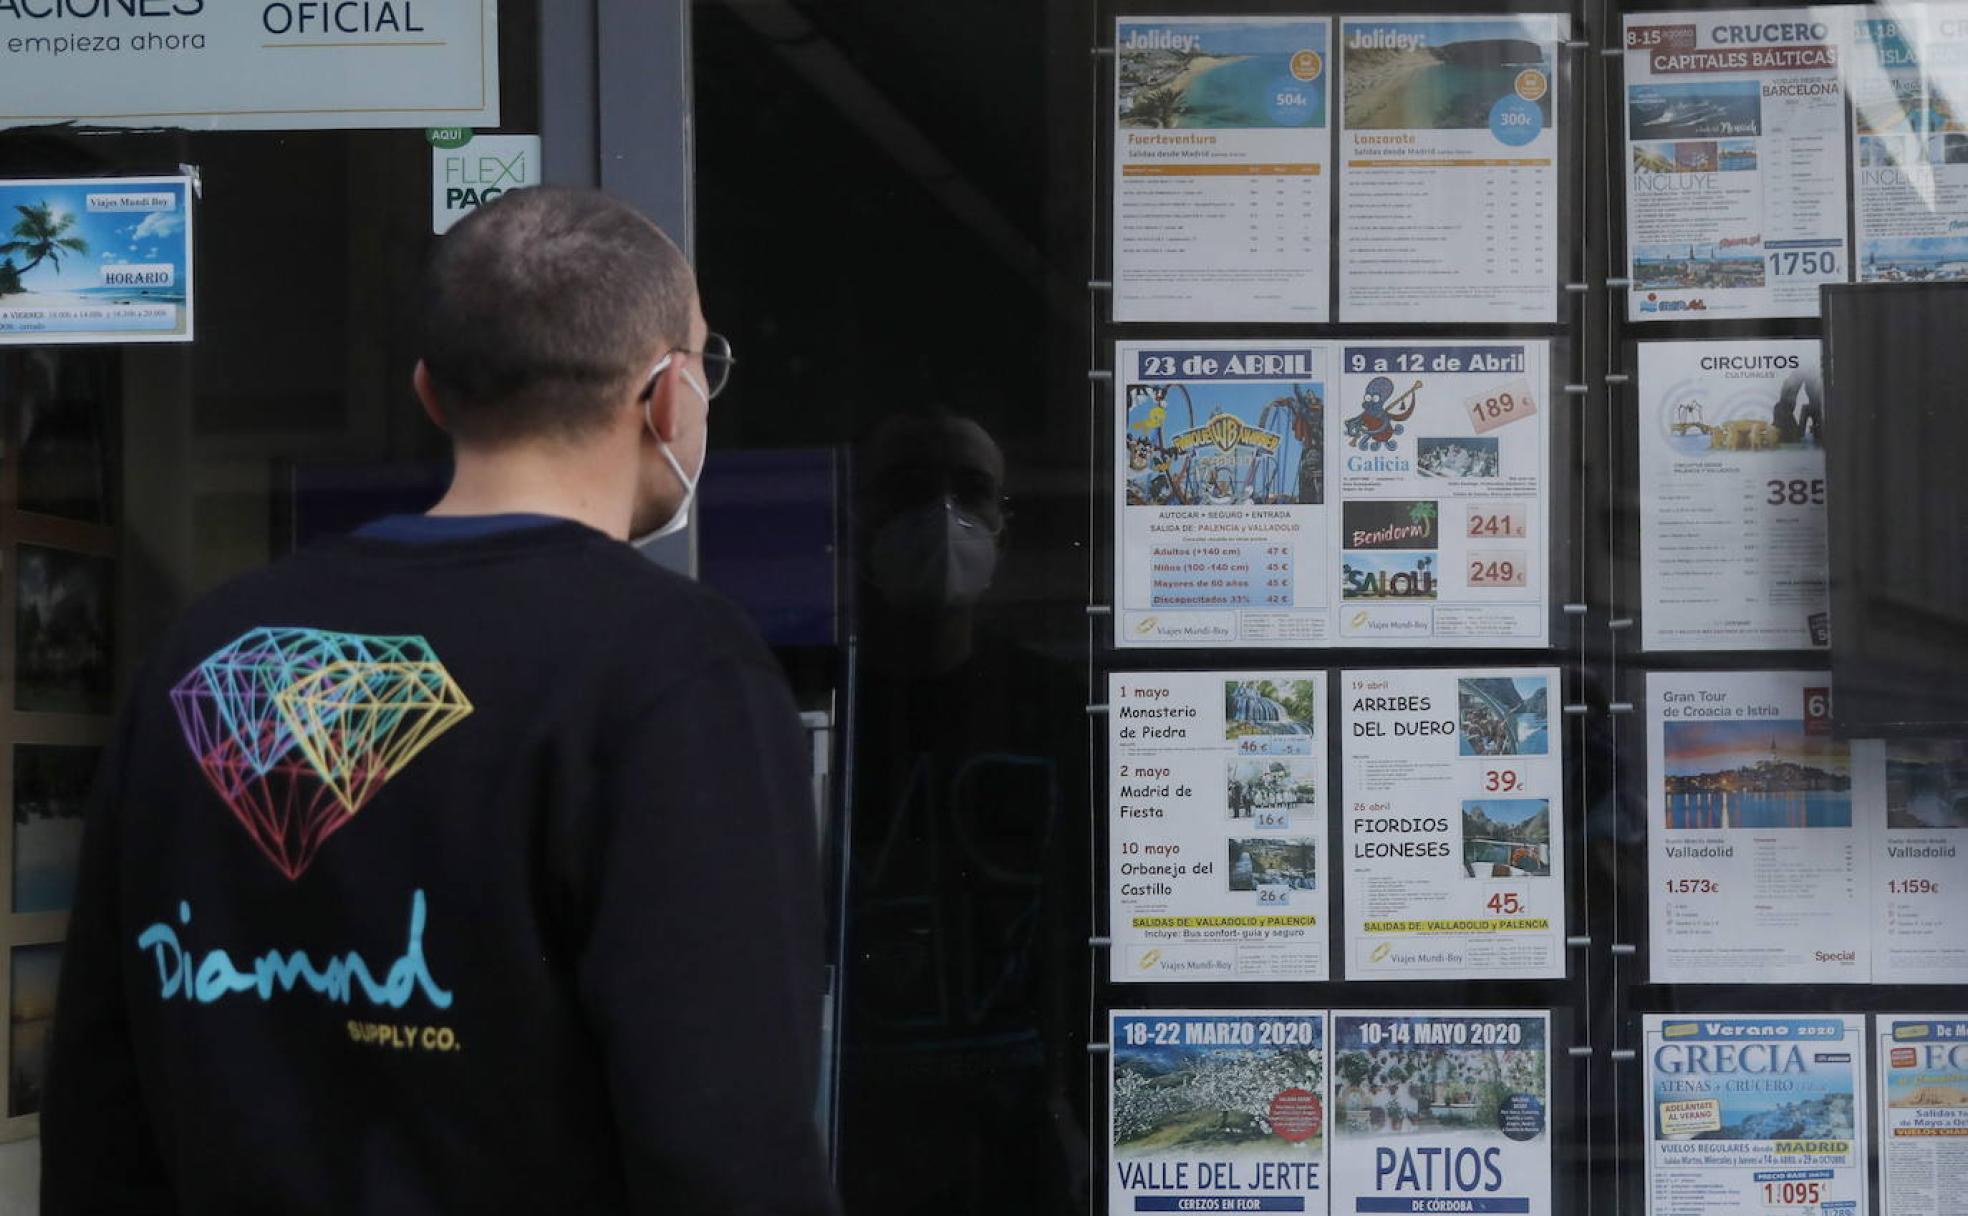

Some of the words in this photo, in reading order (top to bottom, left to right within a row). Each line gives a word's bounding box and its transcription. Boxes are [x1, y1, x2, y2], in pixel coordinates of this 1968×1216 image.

[262, 1, 425, 34] OFICIAL
[1627, 30, 1661, 45] 8-15
[1712, 23, 1829, 44] CRUCERO
[8, 33, 120, 56] empieza
[131, 32, 206, 51] ahora
[1654, 53, 1747, 71] CAPITALES
[1752, 48, 1837, 67] BÁLTICAS
[1762, 83, 1840, 97] BARCELONA
[1128, 133, 1217, 145] Fuerteventura
[1354, 133, 1416, 145] Lanzarote
[1633, 174, 1720, 192] INCLUYE
[105, 272, 169, 284] HORARIO
[1144, 356, 1177, 376] 23
[1182, 355, 1219, 376] de
[1224, 354, 1313, 376] ABRIL
[1352, 354, 1366, 371] 9
[1374, 358, 1389, 371] a
[1397, 354, 1425, 371] 12
[1432, 355, 1461, 371] de
[1468, 354, 1524, 371] Abril
[1701, 356, 1800, 370] CIRCUITOS
[1473, 393, 1515, 422] 189
[1347, 456, 1410, 472] Galicia
[1159, 511, 1199, 519] AUTOCAR
[1208, 511, 1243, 519] SEGURO
[1251, 511, 1291, 519] ENTRADA
[1198, 524, 1239, 532] PALENCIA
[1248, 523, 1300, 531] VALLADOLID
[1470, 515, 1511, 535] 241
[1353, 524, 1424, 547] Benidorm
[1153, 548, 1190, 556] Adultos
[1154, 563, 1180, 571] Niños
[1471, 561, 1514, 581] 249
[1154, 580, 1194, 589] Mayores
[1197, 580, 1209, 588] de
[1349, 571, 1432, 597] SALOU
[1154, 596, 1227, 605] Discapacitados
[1352, 682, 1363, 690] 19
[1368, 681, 1389, 690] abril
[1120, 687, 1126, 697] 1
[1135, 688, 1170, 700] mayo
[1663, 691, 1695, 702] Gran
[1699, 691, 1727, 702] Tour
[1353, 697, 1431, 712] ARRIBES
[1663, 706, 1679, 717] de
[1683, 705, 1732, 717] Croacia
[1736, 708, 1743, 716] e
[1747, 705, 1779, 717] Istria
[1120, 707, 1197, 719] Monasterio
[1120, 727, 1136, 738] de
[1142, 727, 1187, 738] Piedra
[1353, 722, 1386, 737] DEL
[1394, 721, 1456, 736] DUERO
[1120, 766, 1128, 777] 2
[1135, 767, 1170, 780] mayo
[1120, 785, 1170, 797] Madrid
[1176, 785, 1192, 797] de
[1121, 806, 1164, 818] Fiesta
[1354, 803, 1366, 811] 26
[1369, 802, 1391, 811] abril
[1259, 814, 1274, 825] 16
[1354, 818, 1449, 833] FIORDIOS
[1122, 842, 1138, 854] 10
[1145, 844, 1180, 857] mayo
[1354, 843, 1450, 858] LEONESES
[1666, 846, 1734, 858] Valladolid
[1888, 846, 1956, 858] Valladolid
[1121, 863, 1186, 878] Orbaneja
[1192, 862, 1213, 874] del
[1121, 883, 1172, 895] Castillo
[1666, 879, 1720, 893] 1.573€
[1888, 879, 1939, 894] 1.159€
[1260, 890, 1275, 901] 26
[1133, 918, 1175, 927] SALIDAS
[1196, 917, 1257, 926] VALLADOLID
[1267, 916, 1316, 926] PALENCIA
[1364, 922, 1406, 932] SALIDAS
[1427, 921, 1489, 930] VALLADOLID
[1500, 920, 1549, 929] PALENCIA
[1144, 930, 1179, 939] Incluye:
[1183, 929, 1202, 937] Bus
[1272, 930, 1305, 938] seguro
[1391, 954, 1416, 964] Viajes
[1815, 951, 1856, 963] Special
[1160, 961, 1186, 971] Viajes
[347, 1020, 418, 1047] SUPPLY
[421, 1026, 462, 1050] CO.
[1123, 1022, 1181, 1045] 18-22
[1186, 1022, 1254, 1045] MARZO
[1258, 1022, 1313, 1045] 2020
[1359, 1023, 1410, 1044] 10-14
[1414, 1023, 1467, 1044] MAYO
[1471, 1023, 1521, 1044] 2020
[1706, 1023, 1789, 1036] Verano
[1797, 1026, 1836, 1036] 2020
[1653, 1043, 1807, 1074] GRECIA
[1660, 1079, 1711, 1092] ATENAS
[1725, 1078, 1794, 1092] CRUCERO
[1668, 1112, 1679, 1120] AL
[1681, 1110, 1713, 1119] VERANO
[1915, 1109, 1950, 1117] Salidas
[1660, 1143, 1696, 1153] VUELOS
[1698, 1143, 1750, 1153] REGULARES
[1776, 1142, 1850, 1153] MADRID
[1376, 1146, 1503, 1192] PATIOS
[1117, 1162, 1189, 1190] VALLE
[1199, 1162, 1241, 1190] DEL
[1248, 1162, 1320, 1190] JERTE
[1179, 1199, 1220, 1210] CEREZOS
[1222, 1199, 1235, 1209] EN
[1237, 1199, 1261, 1209] FLOR
[1412, 1200, 1425, 1211] DE
